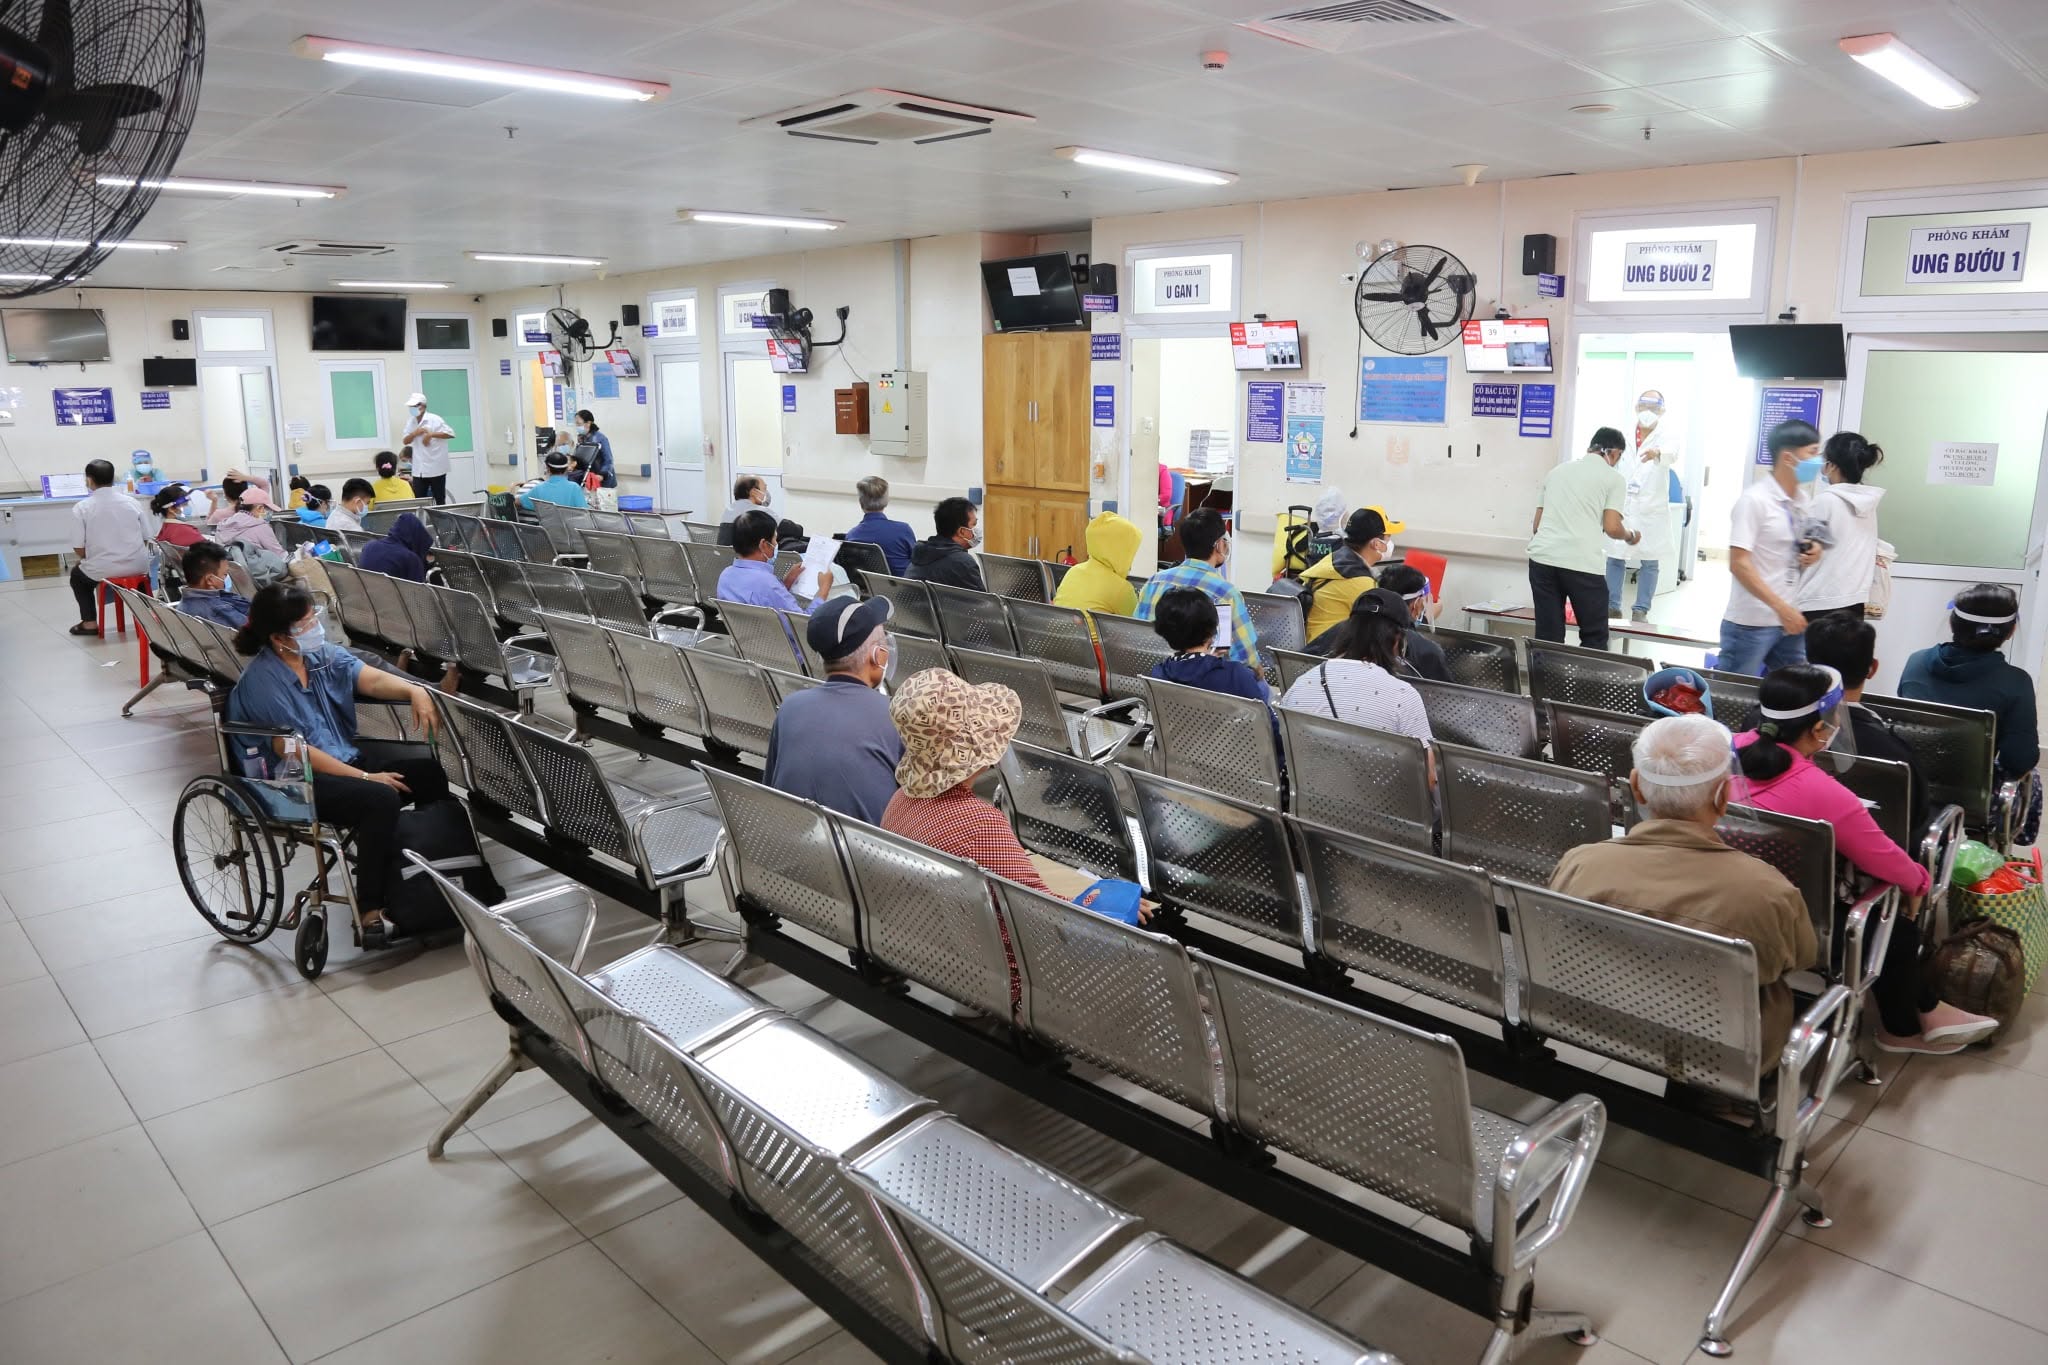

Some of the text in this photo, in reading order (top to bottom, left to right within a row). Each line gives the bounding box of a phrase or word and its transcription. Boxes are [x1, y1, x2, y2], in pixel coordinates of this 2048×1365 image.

[1928, 228, 2010, 242] PHÒNG KHÁM
[1674, 244, 1702, 254] KHÁM
[1912, 248, 2021, 274] UNG BƯỚU 1
[1627, 261, 1712, 283] UNG BƯỚU 2
[1167, 284, 1199, 299] U GAN 1
[1476, 386, 1484, 394] CÔ
